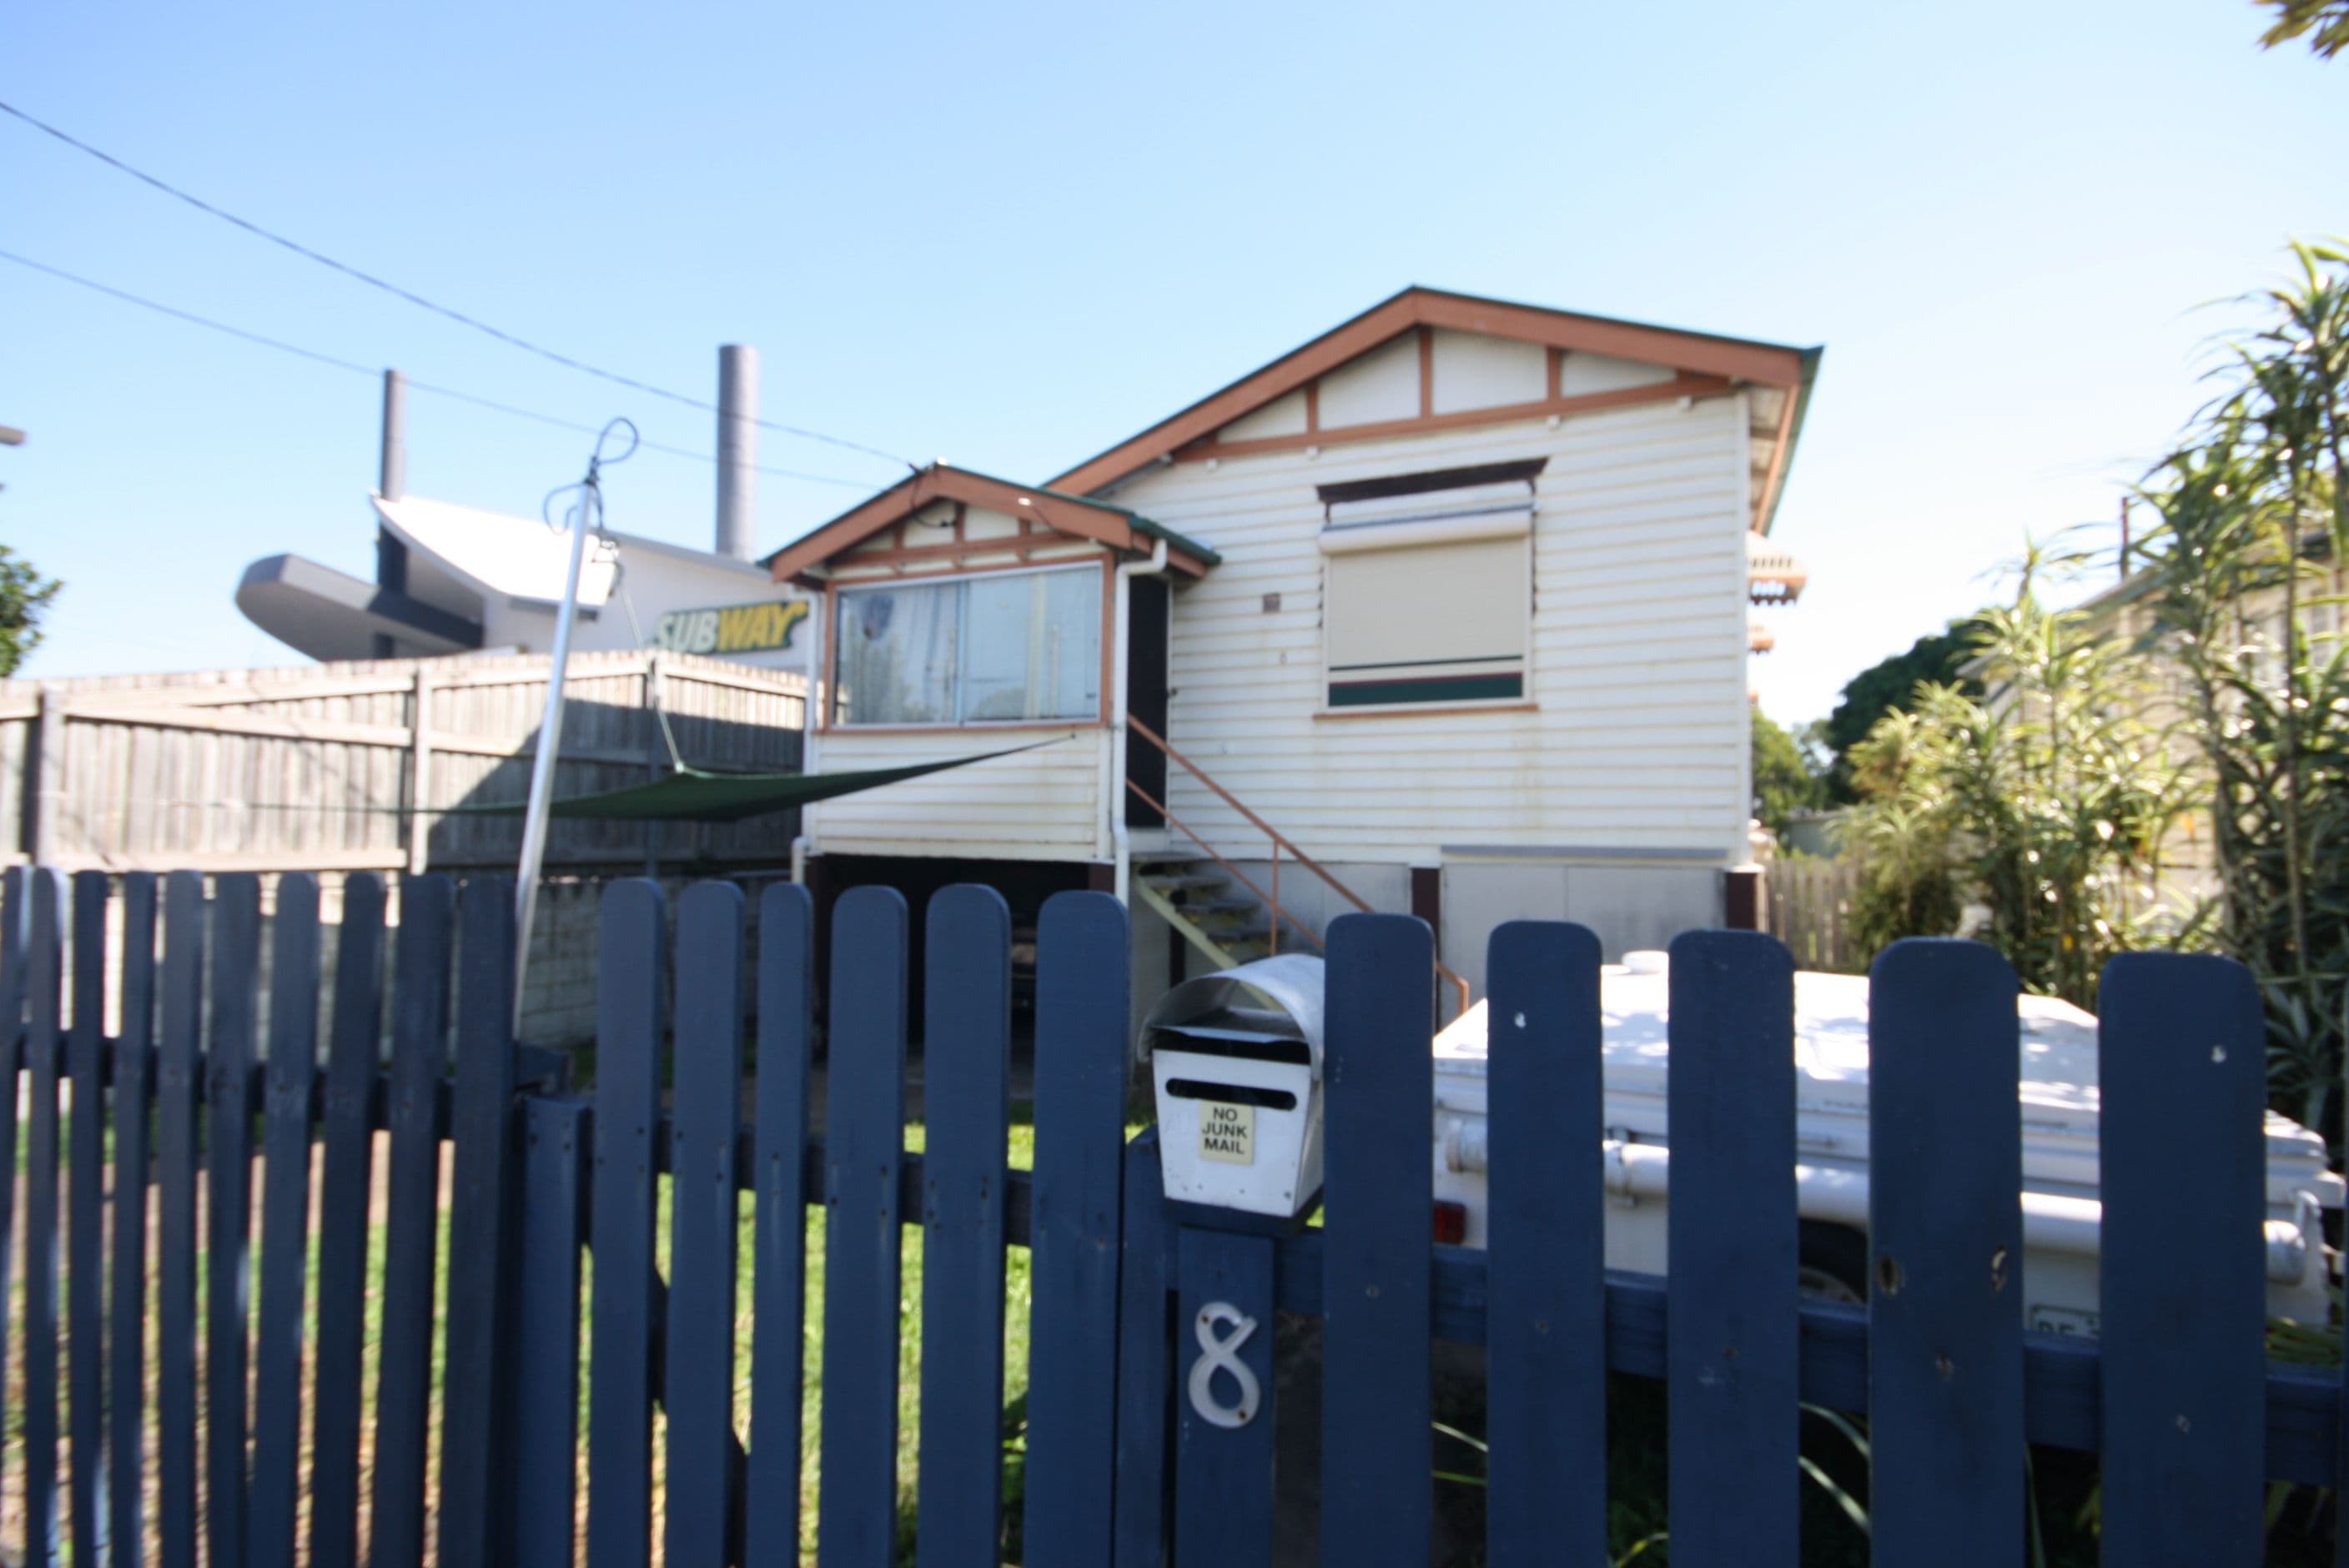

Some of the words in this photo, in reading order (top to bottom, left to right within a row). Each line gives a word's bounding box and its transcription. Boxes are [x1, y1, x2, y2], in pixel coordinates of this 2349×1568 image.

[653, 601, 808, 654] SUBWAY
[1212, 1107, 1238, 1121] NO
[1202, 1122, 1247, 1138] JUNK
[1204, 1138, 1245, 1154] MAIL
[1188, 1301, 1260, 1428] 8
